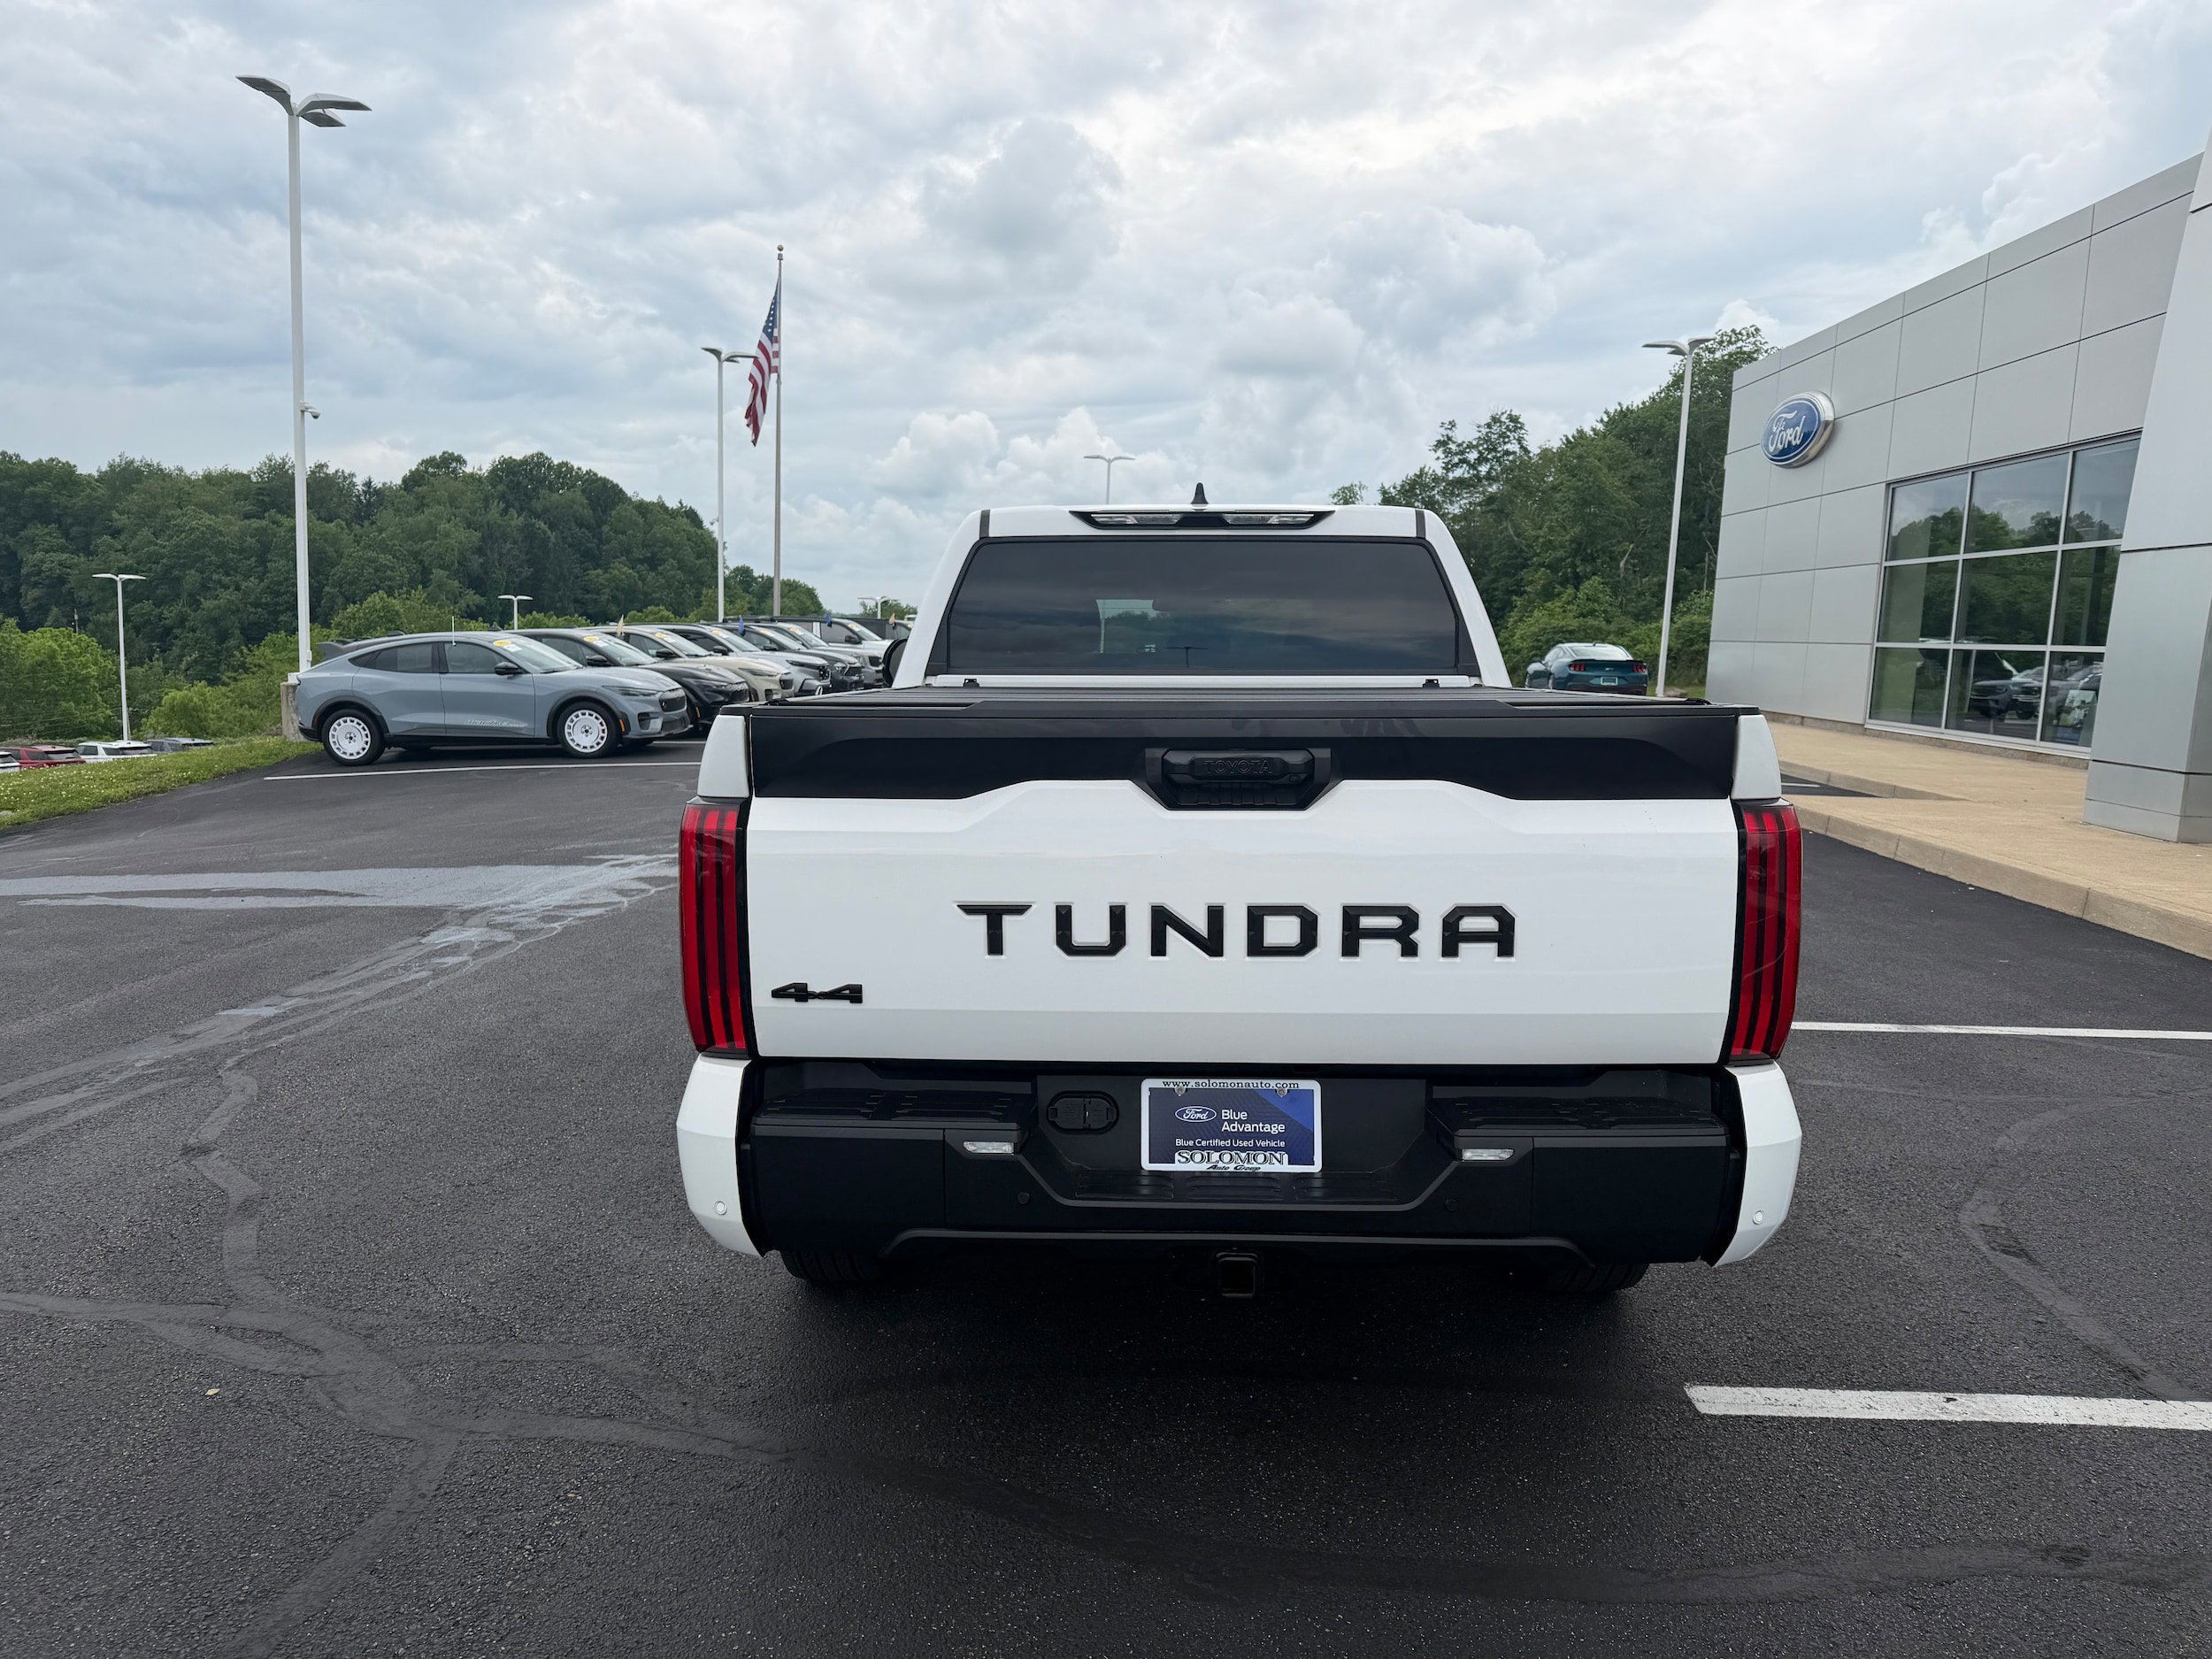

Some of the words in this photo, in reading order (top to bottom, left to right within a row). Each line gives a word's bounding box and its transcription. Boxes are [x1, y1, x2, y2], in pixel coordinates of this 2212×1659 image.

[1769, 410, 1806, 453] Ford
[1203, 759, 1273, 774] TOYOTA
[956, 903, 1517, 958] TUNDRA
[1162, 1079, 1300, 1089] www.solomonauto.com
[1182, 1108, 1210, 1120] Ford
[1221, 1109, 1248, 1120] Blue
[1221, 1121, 1286, 1134] Advantage
[1175, 1138, 1194, 1147] Blue
[1195, 1138, 1232, 1148] Certified
[1233, 1139, 1254, 1148] Used
[1256, 1139, 1286, 1148] Vehicle
[1177, 1149, 1286, 1165] SOLOMON
